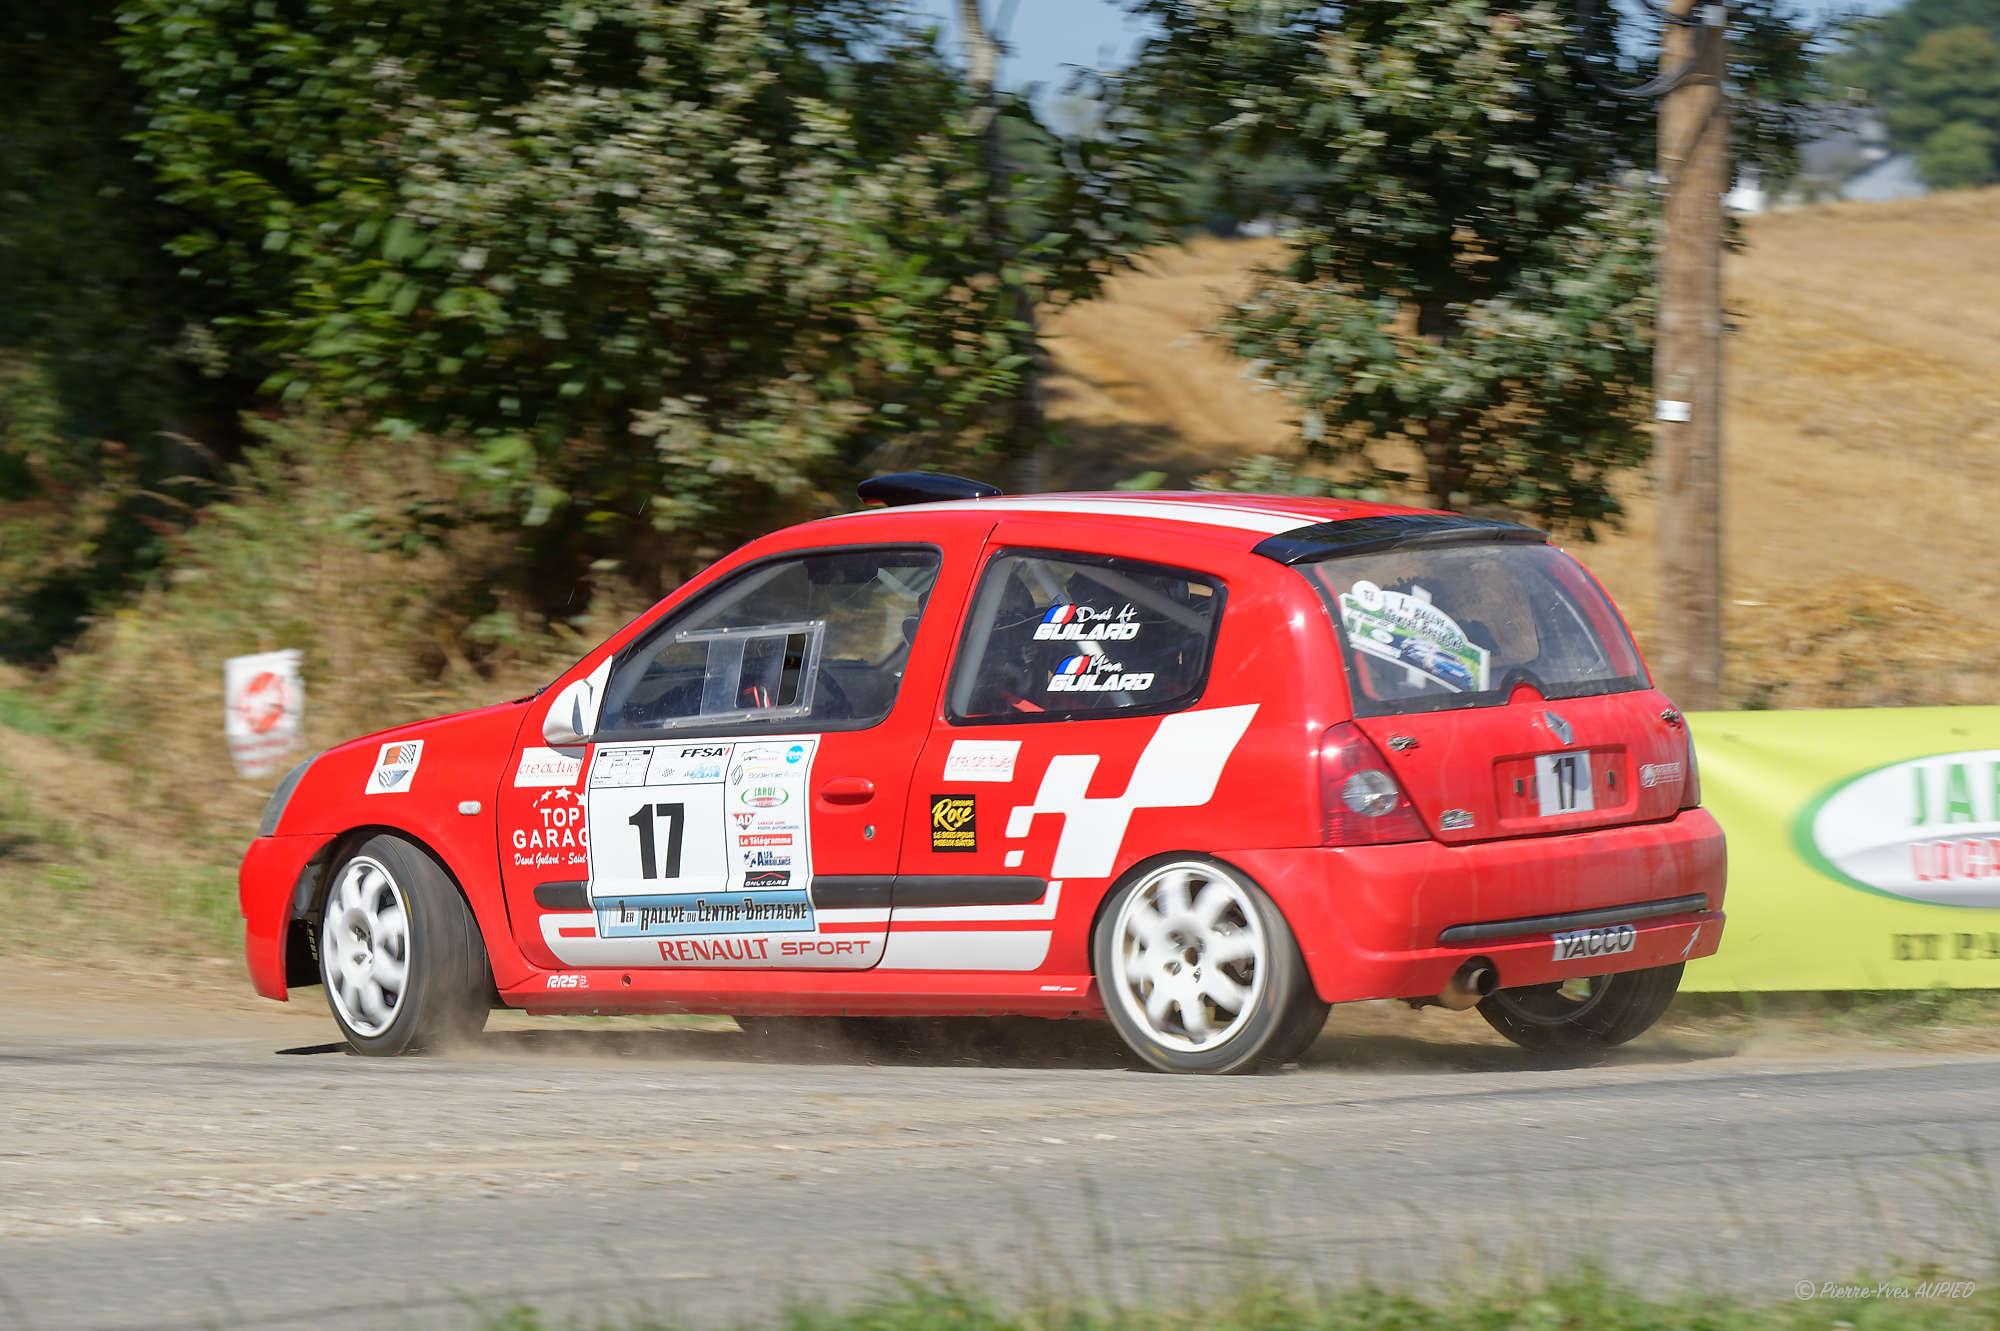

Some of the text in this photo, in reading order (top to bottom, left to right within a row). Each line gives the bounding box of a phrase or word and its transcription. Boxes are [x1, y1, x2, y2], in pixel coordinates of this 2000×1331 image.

[1032, 623, 1141, 640] GUILARD
[1047, 673, 1155, 692] GUILARD
[680, 748, 723, 758] FFSA
[1552, 757, 1575, 810] 17
[540, 808, 580, 827] TOP
[737, 814, 754, 826] AD
[931, 798, 975, 831] Rose
[628, 802, 685, 880] 17
[740, 835, 792, 847] Le Télégramme
[640, 905, 685, 931] RALLYE
[687, 912, 697, 923] DU
[658, 938, 871, 962] RENAULT SPORT
[1560, 926, 1632, 958] YACCO
[547, 974, 579, 988] RRS
